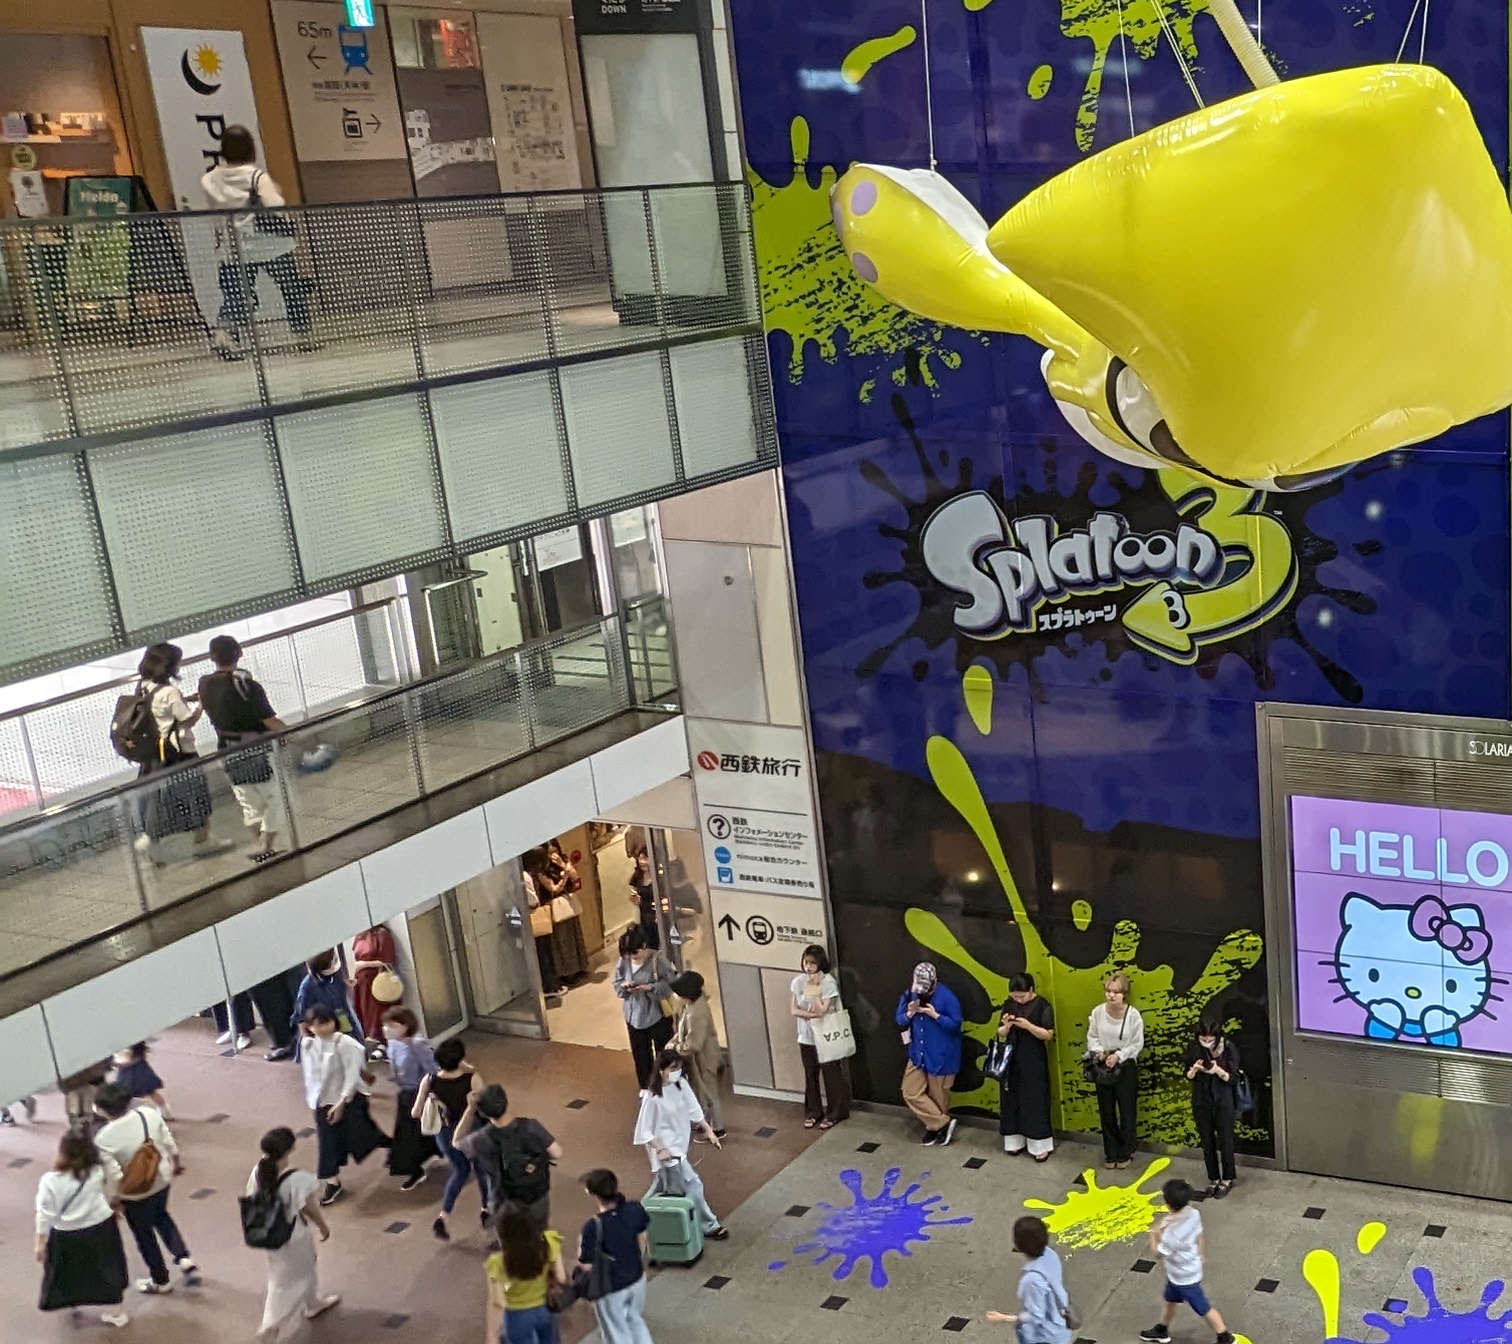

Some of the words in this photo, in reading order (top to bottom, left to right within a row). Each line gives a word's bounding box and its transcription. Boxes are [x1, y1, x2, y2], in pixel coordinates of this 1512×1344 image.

[601, 5, 627, 14] DOWN
[297, 21, 332, 39] 65m
[921, 489, 1226, 632] Splatoon
[1038, 603, 1117, 631] スプラトゥーン
[720, 753, 801, 777] 西鉄旅行
[1329, 827, 1510, 887] HELLO
